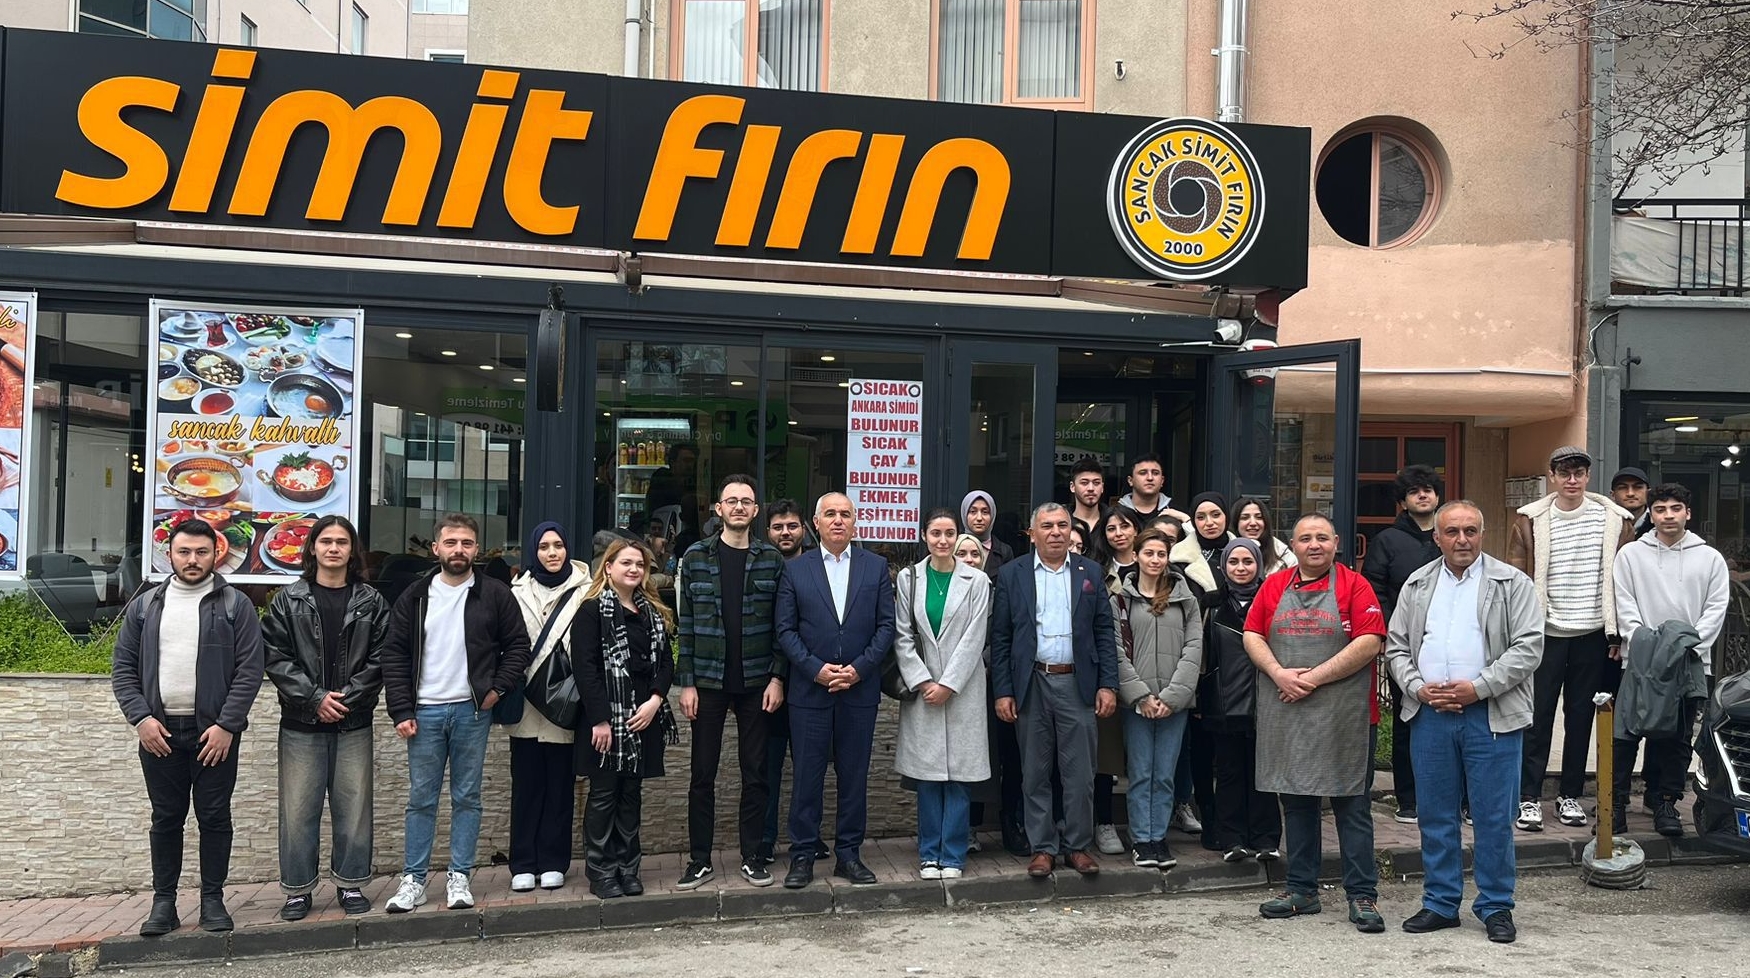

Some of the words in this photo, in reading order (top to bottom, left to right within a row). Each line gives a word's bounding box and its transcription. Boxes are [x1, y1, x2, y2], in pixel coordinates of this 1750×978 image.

[54, 48, 593, 236] simit
[1131, 140, 1177, 224] SANCAK
[1182, 136, 1236, 176] SİMİT
[1216, 182, 1244, 240] FIRIN
[1164, 241, 1203, 255] 2000
[863, 382, 908, 396] SICAK
[851, 400, 887, 414] ANKARA
[888, 399, 919, 415] SİMİDİ
[168, 413, 247, 440] sancak
[851, 418, 919, 433] BULUNUR
[862, 437, 908, 450] SICAK
[870, 454, 898, 469] ÇAY
[850, 472, 918, 486] BULUNUR
[859, 490, 908, 504] EKMEK
[854, 506, 919, 523] EŞİTLERİ
